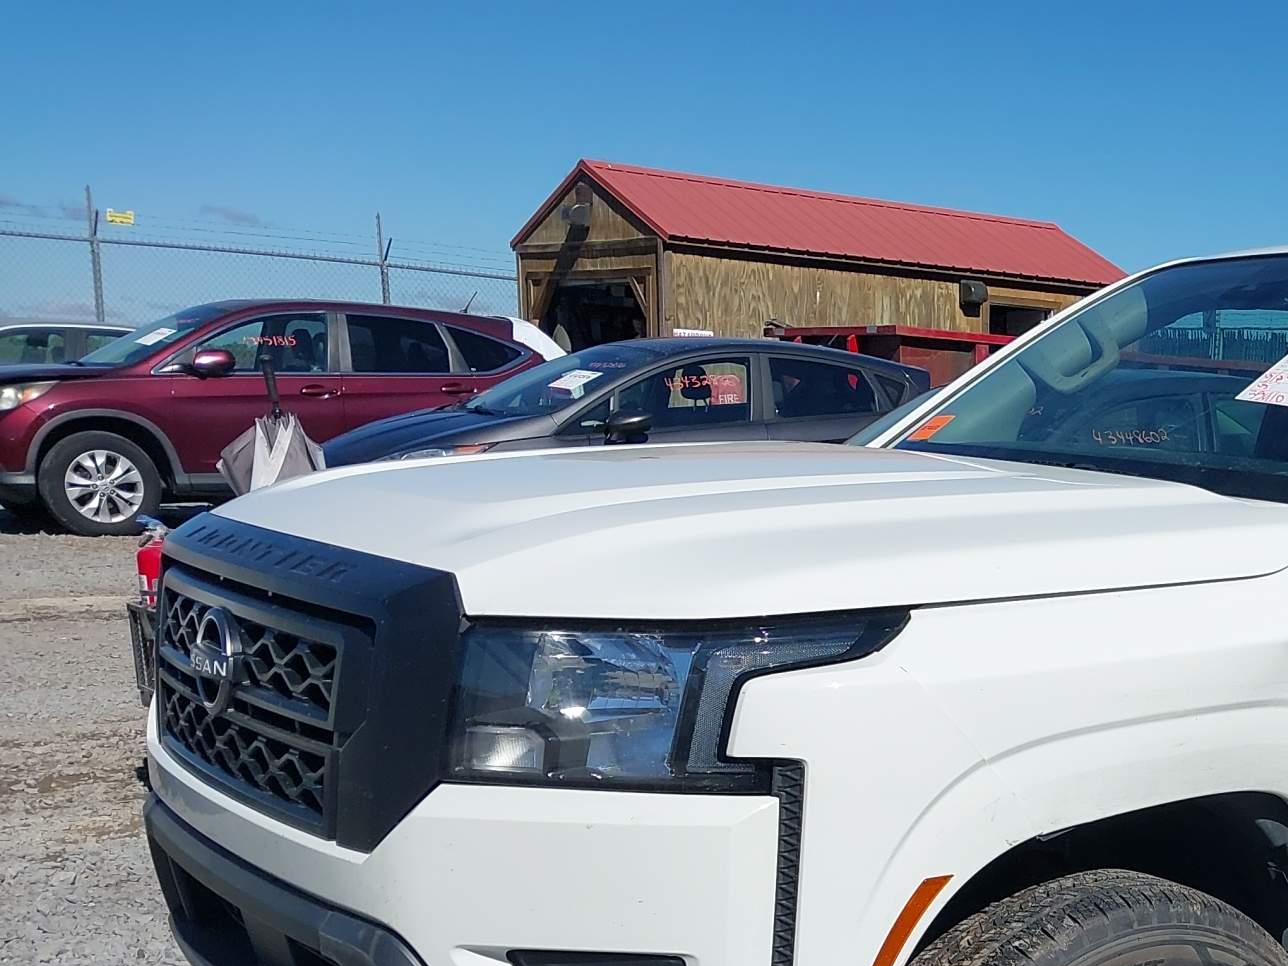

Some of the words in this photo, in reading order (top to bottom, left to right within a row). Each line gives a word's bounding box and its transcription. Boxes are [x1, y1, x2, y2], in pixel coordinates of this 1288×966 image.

[719, 393, 740, 405] FIRE
[186, 525, 358, 583] FRONTIER
[190, 653, 227, 677] SSAN
